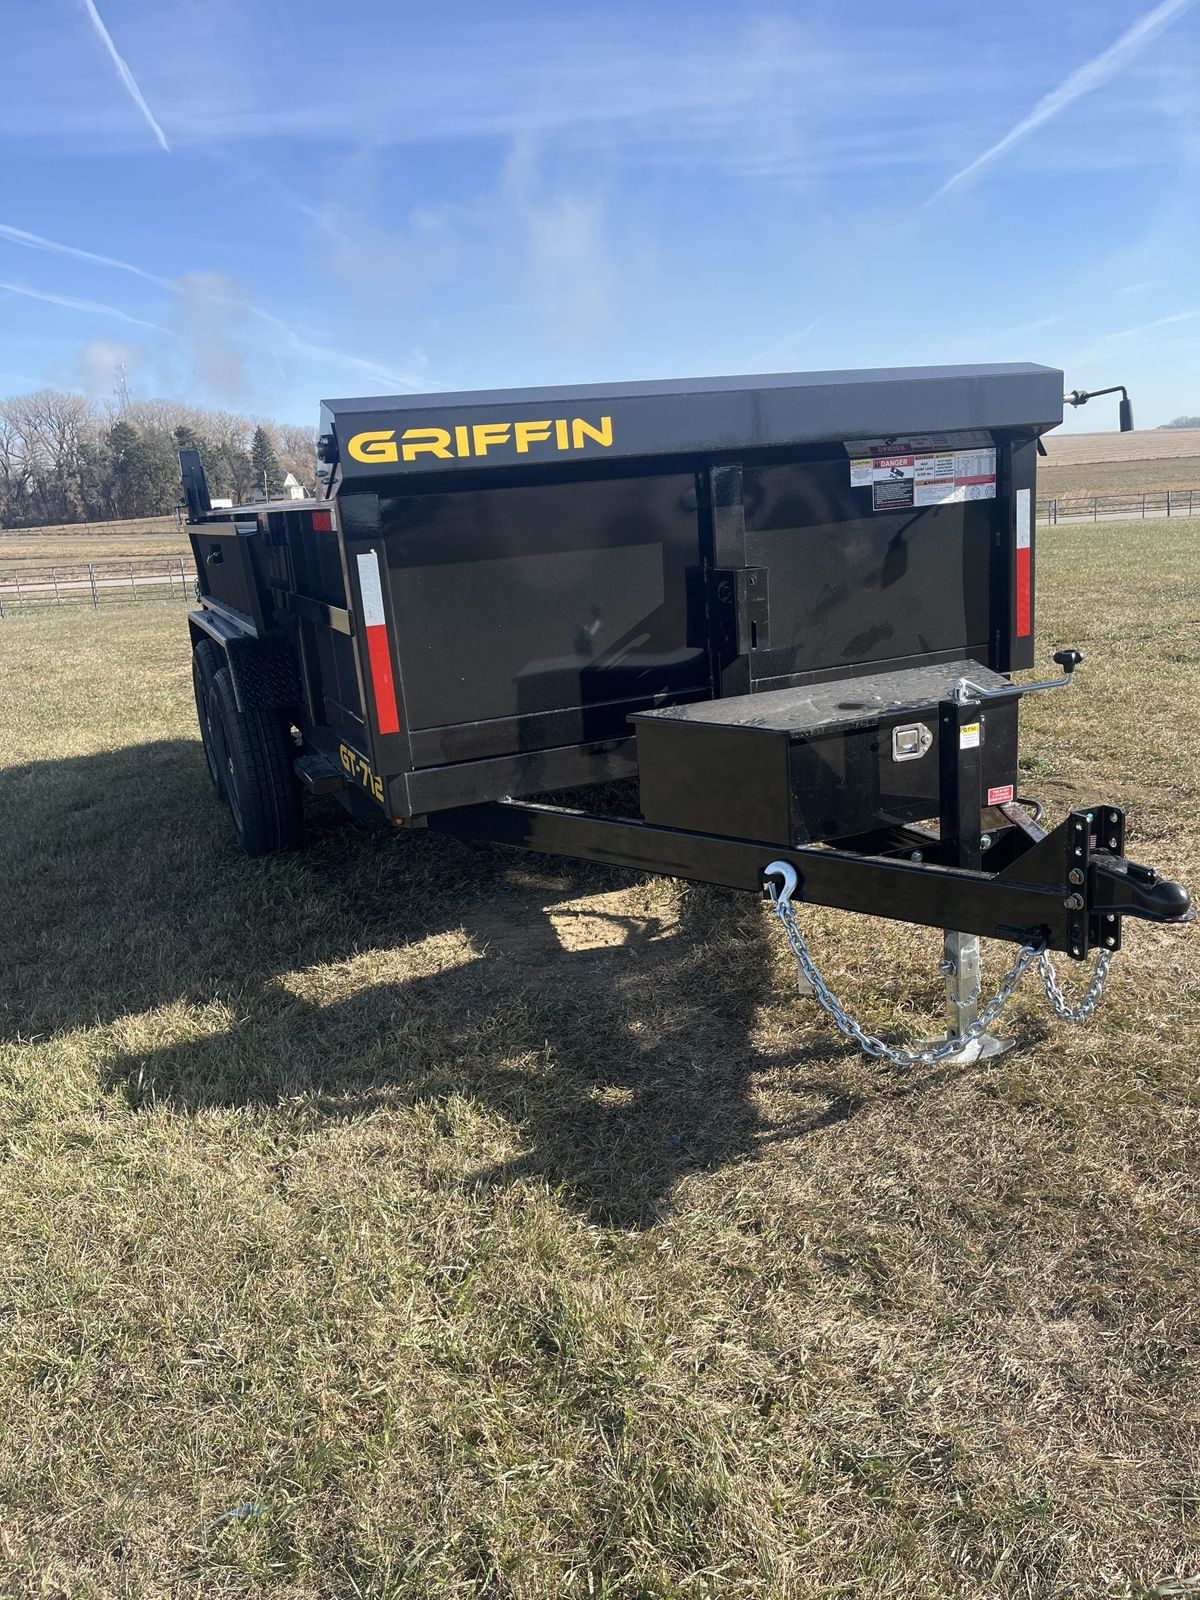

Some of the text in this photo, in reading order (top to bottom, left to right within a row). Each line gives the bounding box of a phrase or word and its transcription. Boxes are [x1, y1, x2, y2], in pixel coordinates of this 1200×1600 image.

[348, 416, 612, 463] GRIFFIN
[880, 458, 908, 468] DANGER
[340, 743, 384, 803] GT-712
